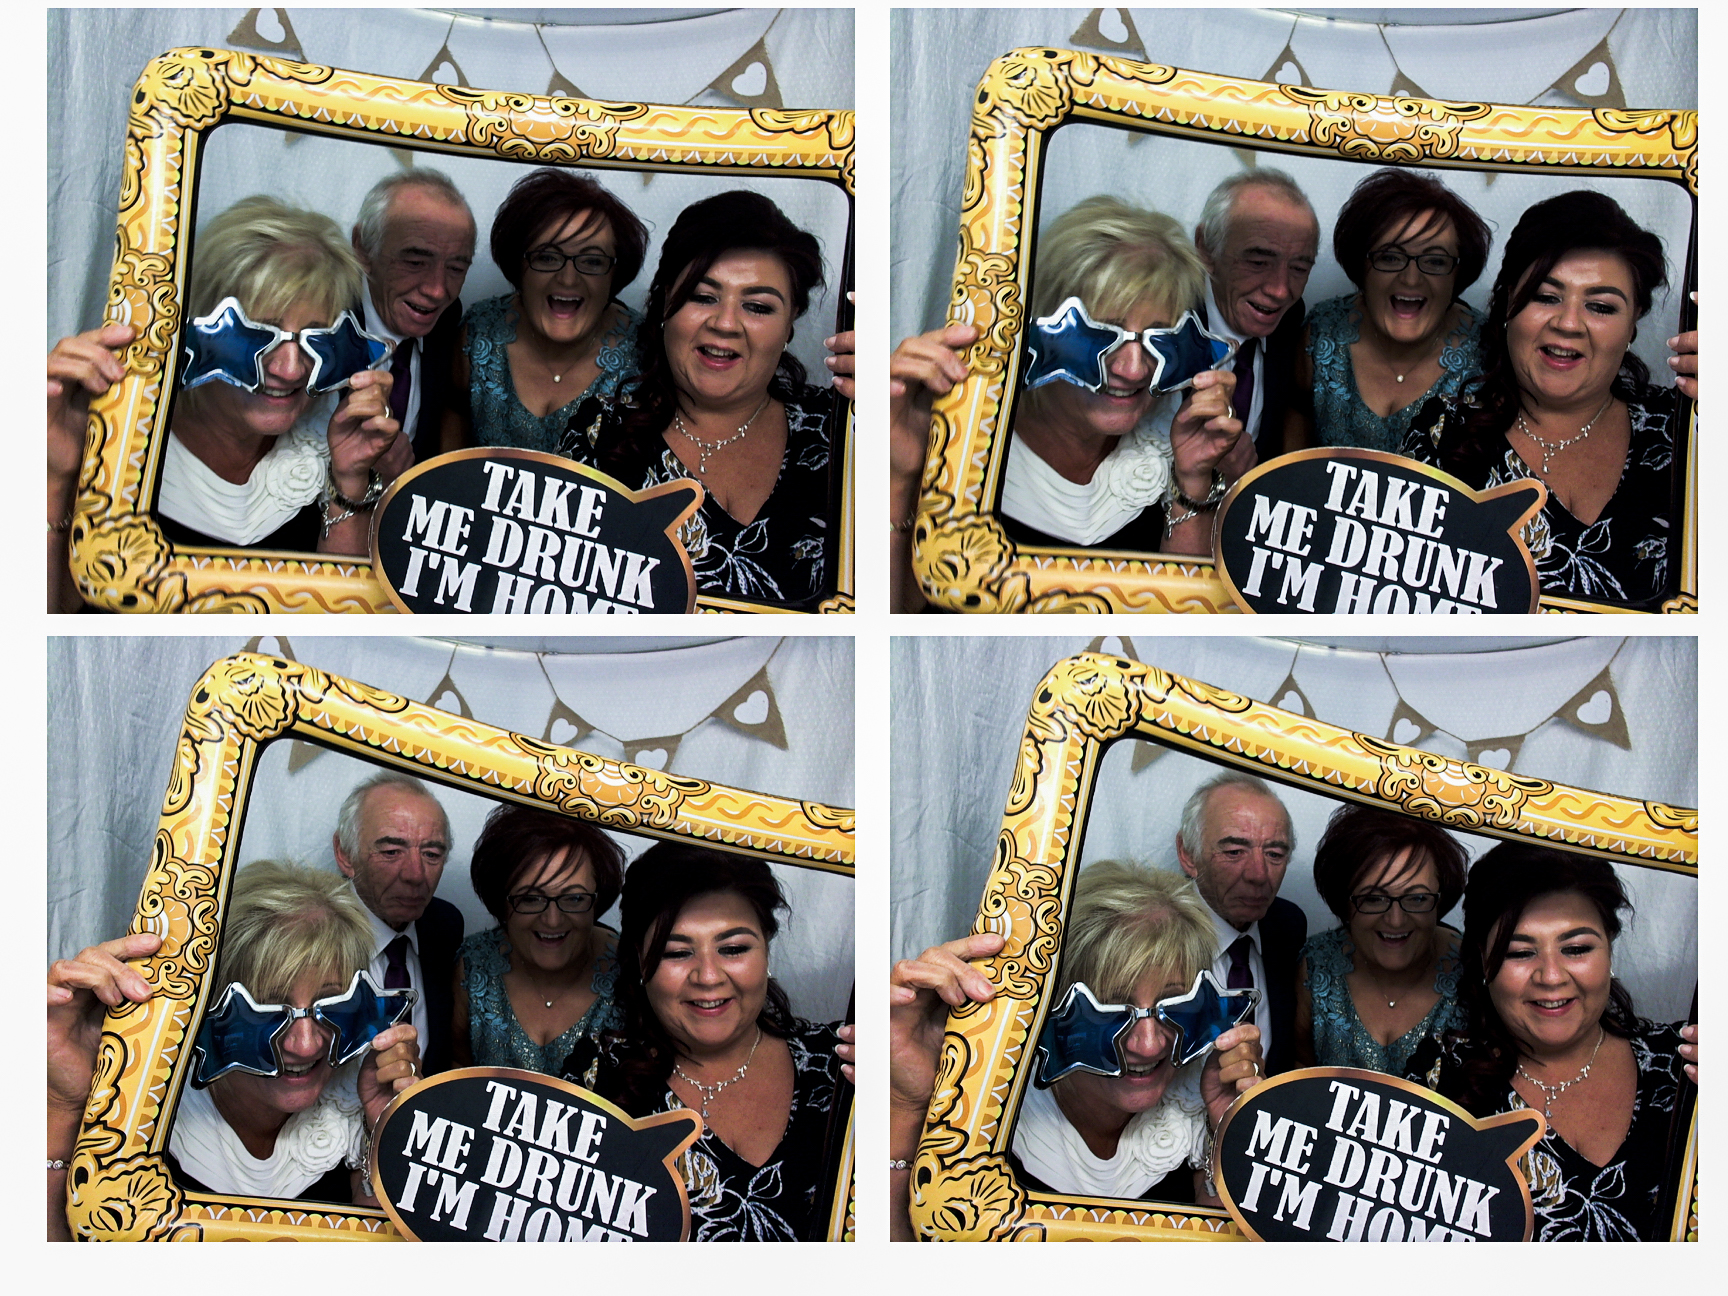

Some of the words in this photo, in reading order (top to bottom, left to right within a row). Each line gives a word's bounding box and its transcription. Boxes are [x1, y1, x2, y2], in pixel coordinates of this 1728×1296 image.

[480, 460, 607, 539] TAKE
[1323, 460, 1450, 539] TAKE
[398, 546, 482, 613] I'M
[401, 493, 475, 557] ME
[481, 515, 661, 609] DRUNK
[1241, 546, 1325, 613] I'M
[1244, 493, 1318, 557] ME
[1324, 515, 1504, 609] DRUNK
[481, 1080, 607, 1165] TAKE
[1324, 1080, 1450, 1165] TAKE
[395, 1161, 480, 1232] I'M
[401, 1109, 475, 1175] ME
[479, 1135, 658, 1238] DRUNK
[1238, 1161, 1323, 1232] I'M
[1244, 1109, 1318, 1175] ME
[1322, 1135, 1501, 1238] DRUNK
